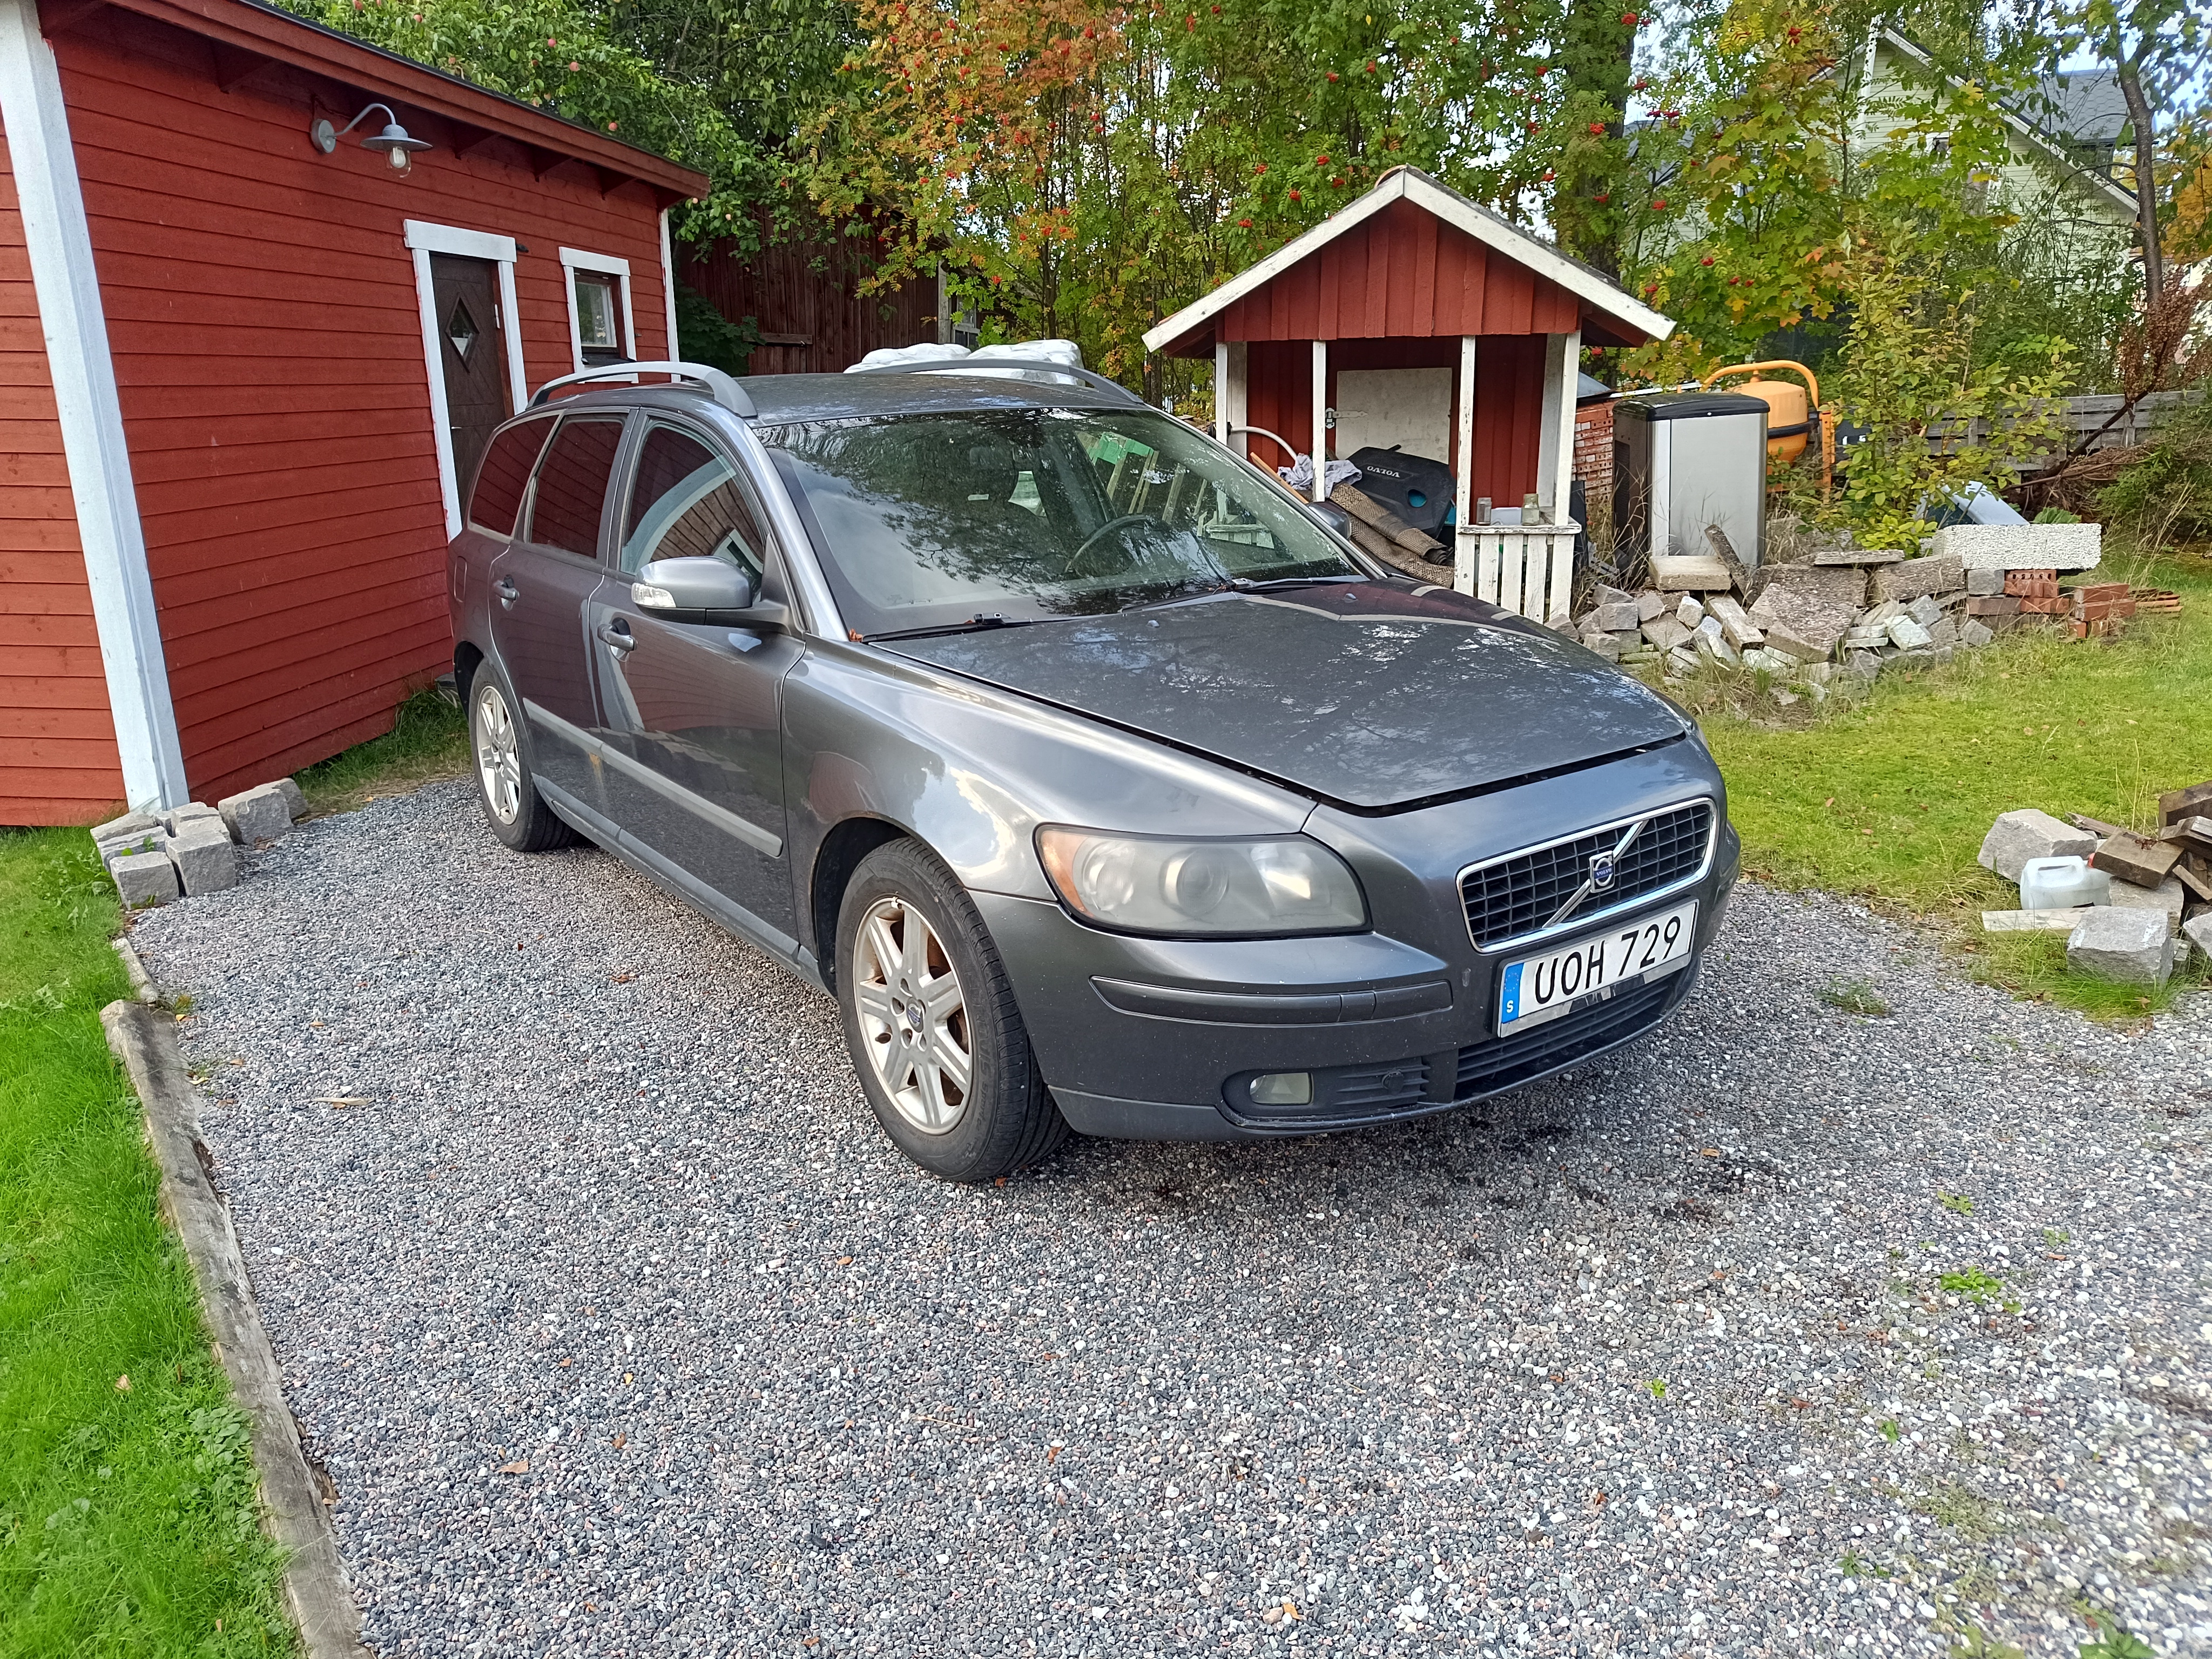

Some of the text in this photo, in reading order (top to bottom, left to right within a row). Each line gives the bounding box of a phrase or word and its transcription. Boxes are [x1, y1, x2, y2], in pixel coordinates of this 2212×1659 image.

[1367, 466, 1400, 477] VOLVO
[1596, 867, 1612, 876] VOLVO
[1534, 915, 1681, 1004] UOH 729
[1506, 1000, 1514, 1013] S
